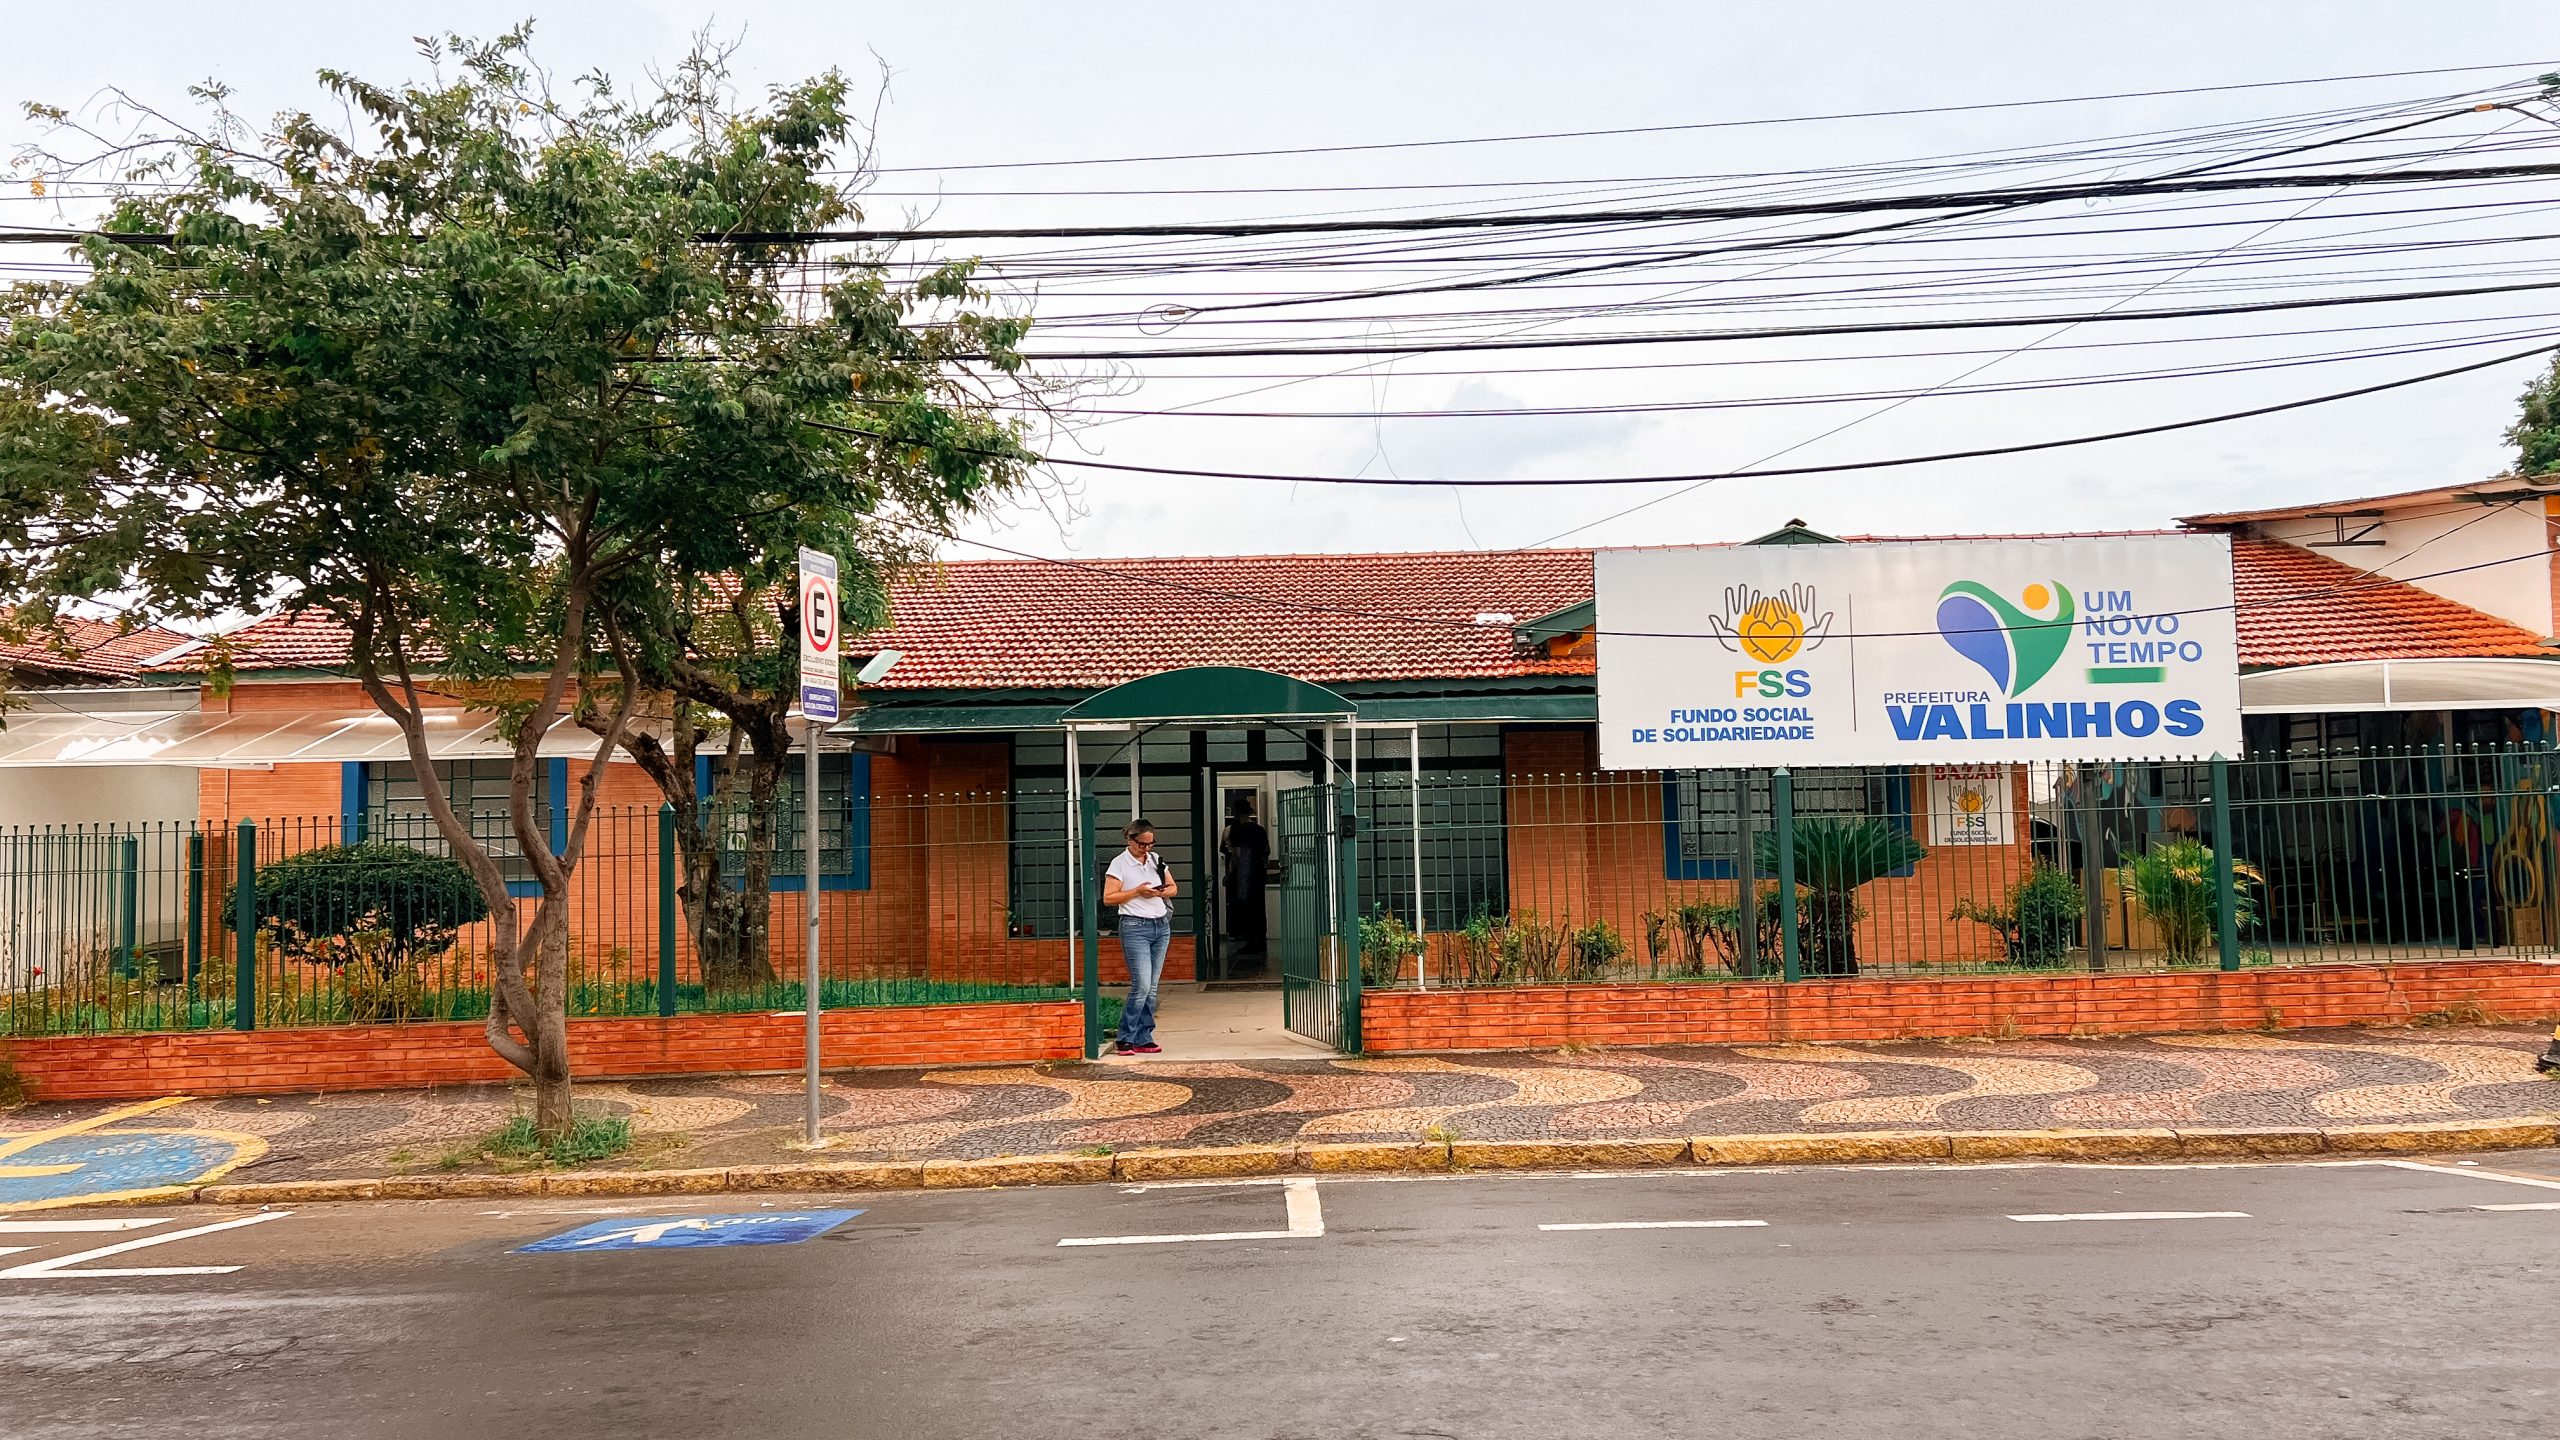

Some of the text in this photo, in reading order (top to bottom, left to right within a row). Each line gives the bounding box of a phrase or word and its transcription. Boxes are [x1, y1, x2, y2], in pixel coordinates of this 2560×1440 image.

[2084, 590, 2132, 612] UM
[814, 590, 825, 638] E
[2086, 614, 2179, 636] NOVO
[2087, 641, 2203, 664] TEMPO
[1735, 669, 1812, 698] FSS
[1884, 691, 1991, 704] PREFEITURA
[1670, 707, 1814, 724] FUNDO SOCIAL
[1886, 699, 2205, 741] VALINHOS
[1632, 726, 1815, 743] DE SOLIDARIEDADE
[1934, 766, 2004, 780] BAZAR
[1957, 816, 1985, 827] FSS
